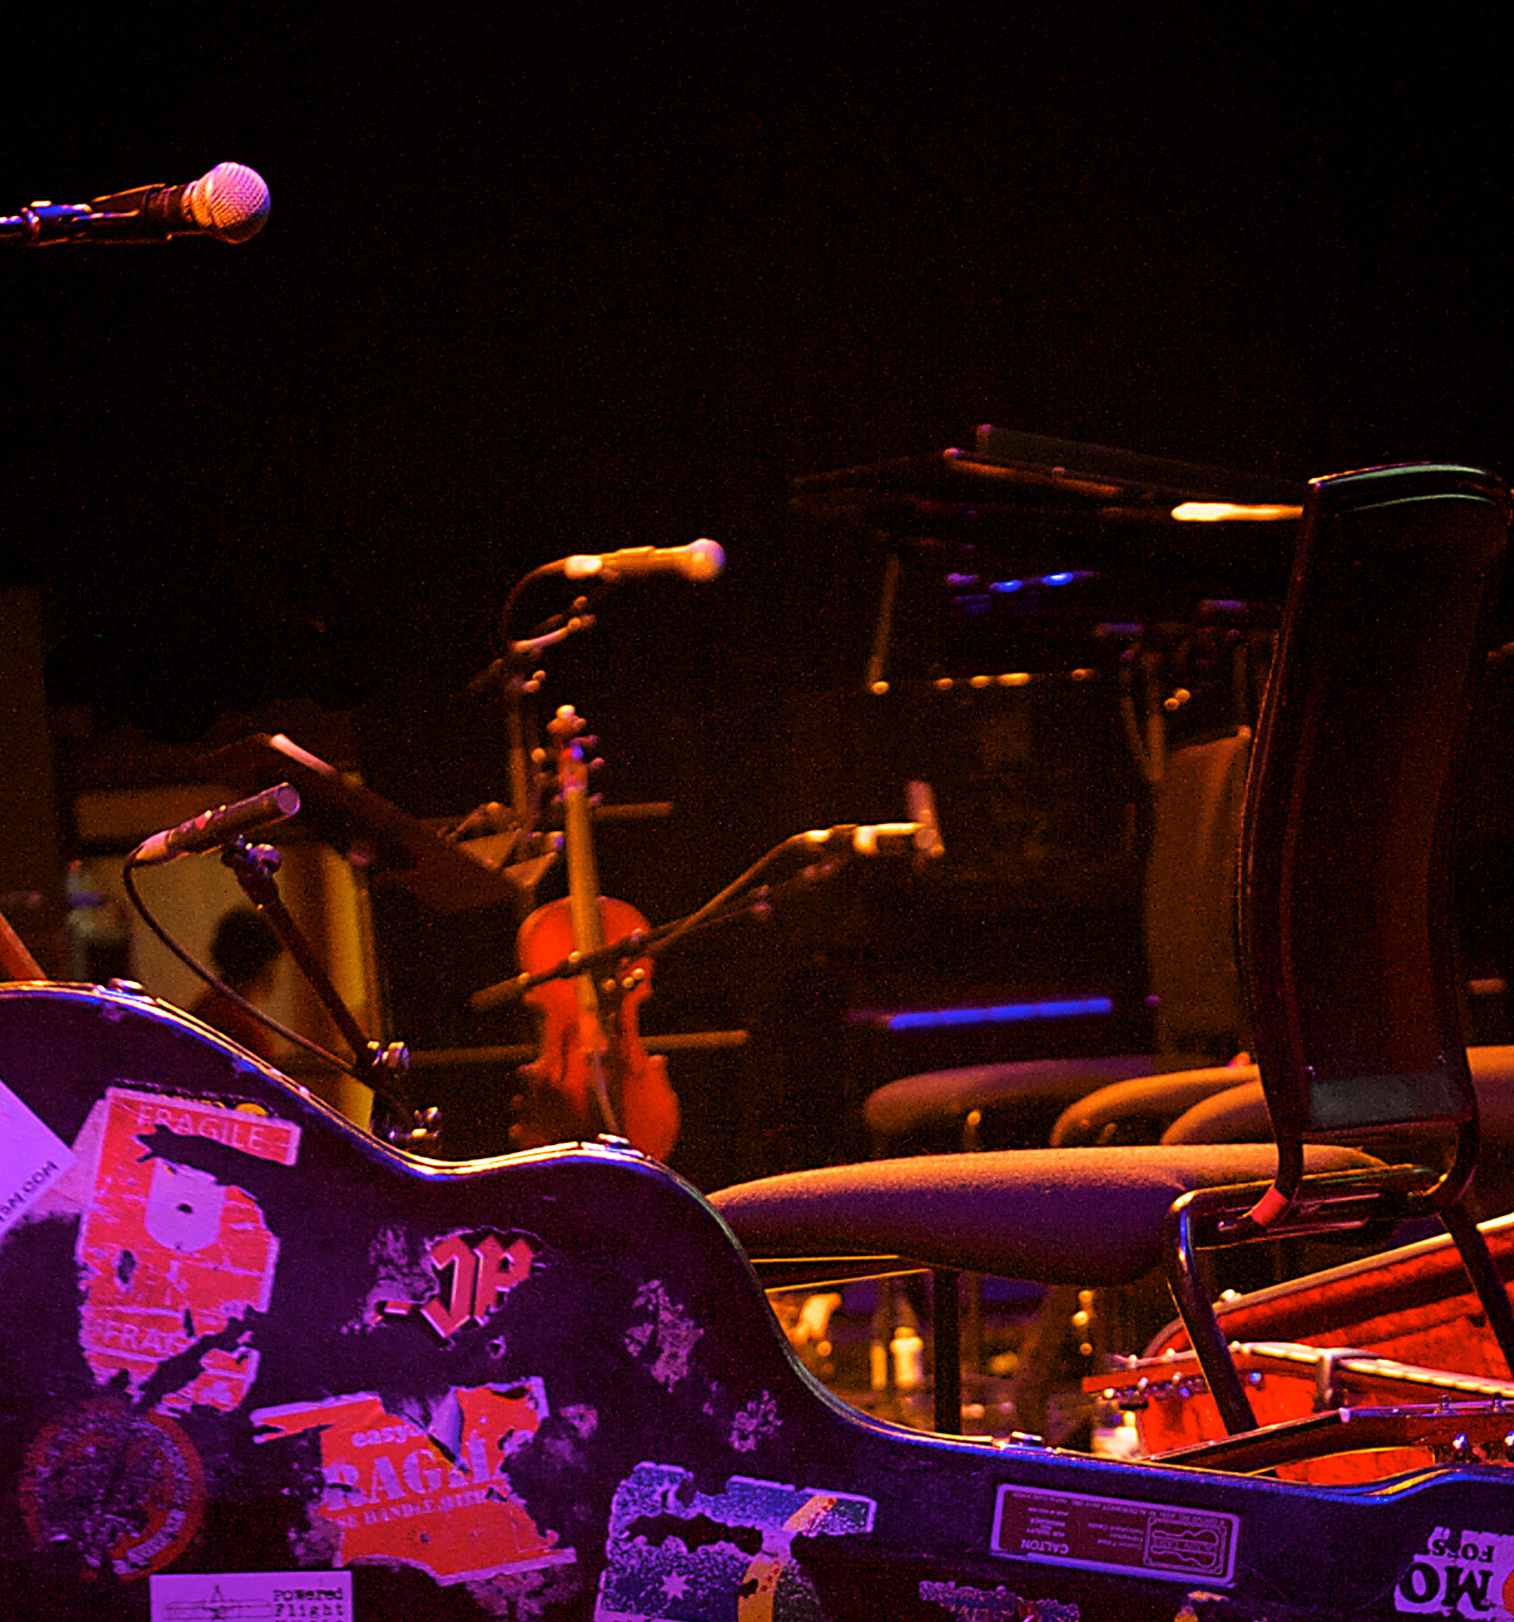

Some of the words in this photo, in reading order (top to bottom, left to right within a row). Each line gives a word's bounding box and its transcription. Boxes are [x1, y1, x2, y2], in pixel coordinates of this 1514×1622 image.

[135, 1104, 266, 1151] FRAGILE
[1021, 1539, 1069, 1555] CALTON
[1431, 1539, 1494, 1563] FOS
[273, 1587, 342, 1601] Powered
[275, 1603, 343, 1617] Flight
